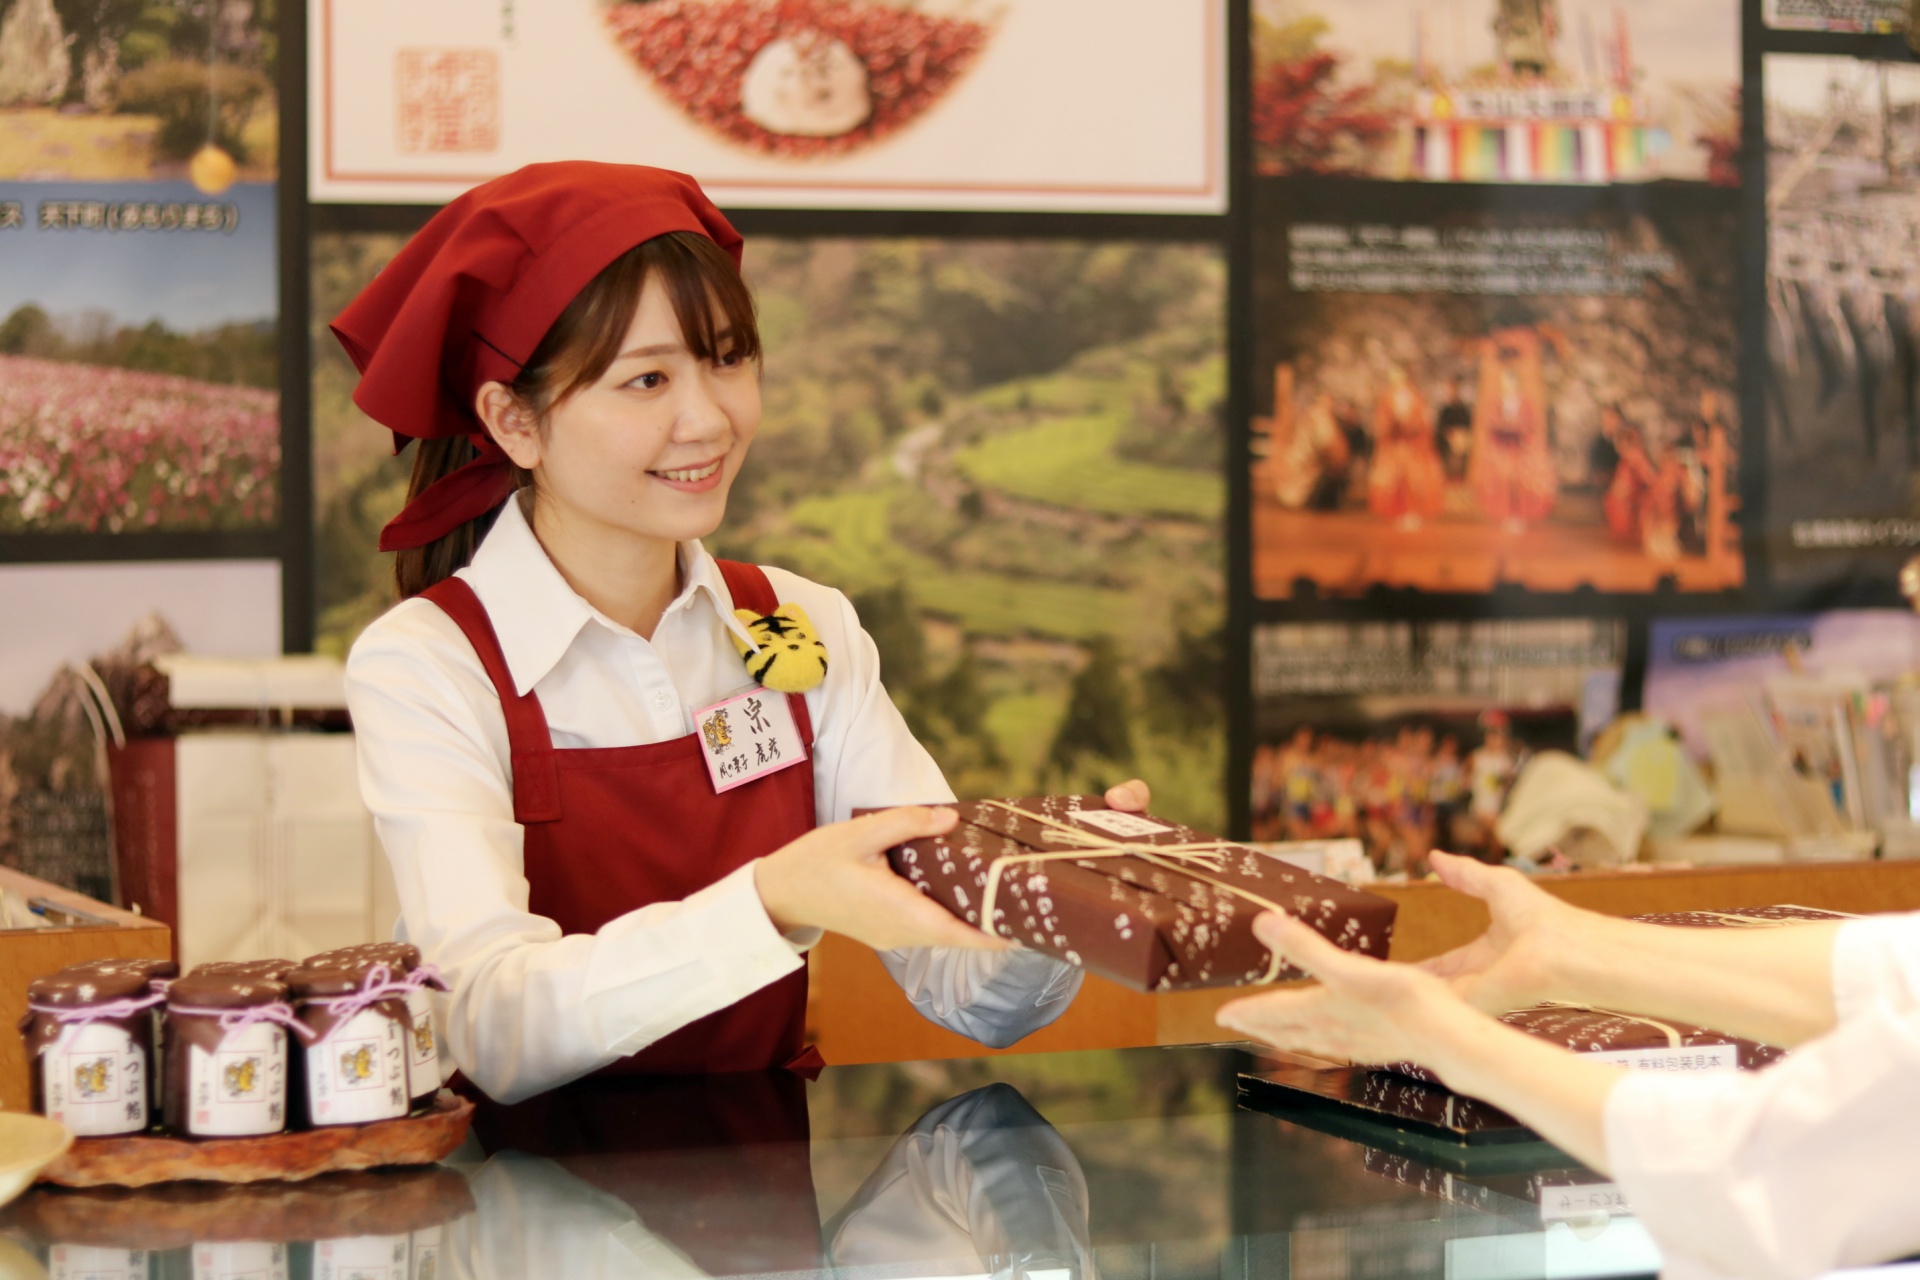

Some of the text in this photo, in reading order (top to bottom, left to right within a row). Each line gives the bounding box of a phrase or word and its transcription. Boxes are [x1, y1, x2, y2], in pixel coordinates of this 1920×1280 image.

[743, 697, 771, 735] 宗
[1637, 1054, 1722, 1072] 有料包装見本
